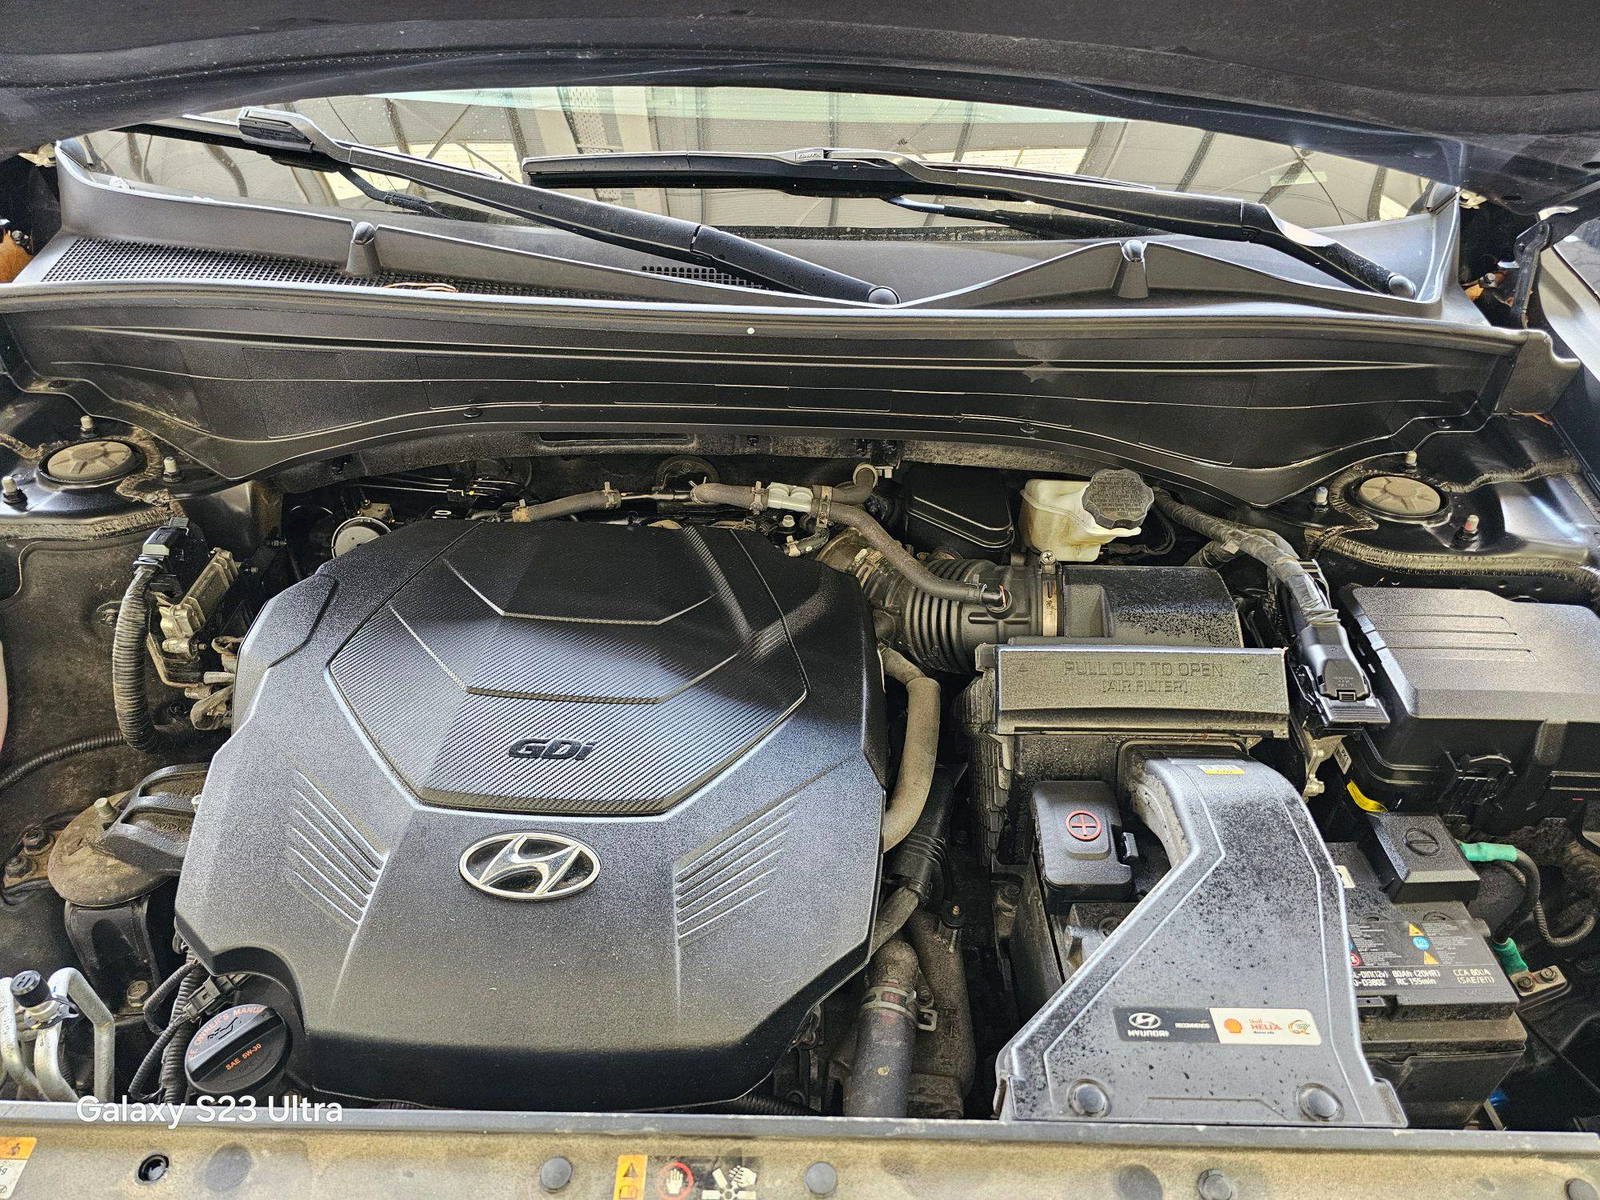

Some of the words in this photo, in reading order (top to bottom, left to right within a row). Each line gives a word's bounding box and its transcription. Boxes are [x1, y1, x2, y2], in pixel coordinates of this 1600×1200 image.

[1063, 660, 1107, 677] PULL
[1112, 660, 1148, 677] OUT
[1149, 661, 1173, 677] TO
[1178, 662, 1224, 678] OPEN
[508, 738, 598, 761] GDi
[1452, 968, 1471, 977] CCA
[1127, 1029, 1170, 1037] HYUNDAI
